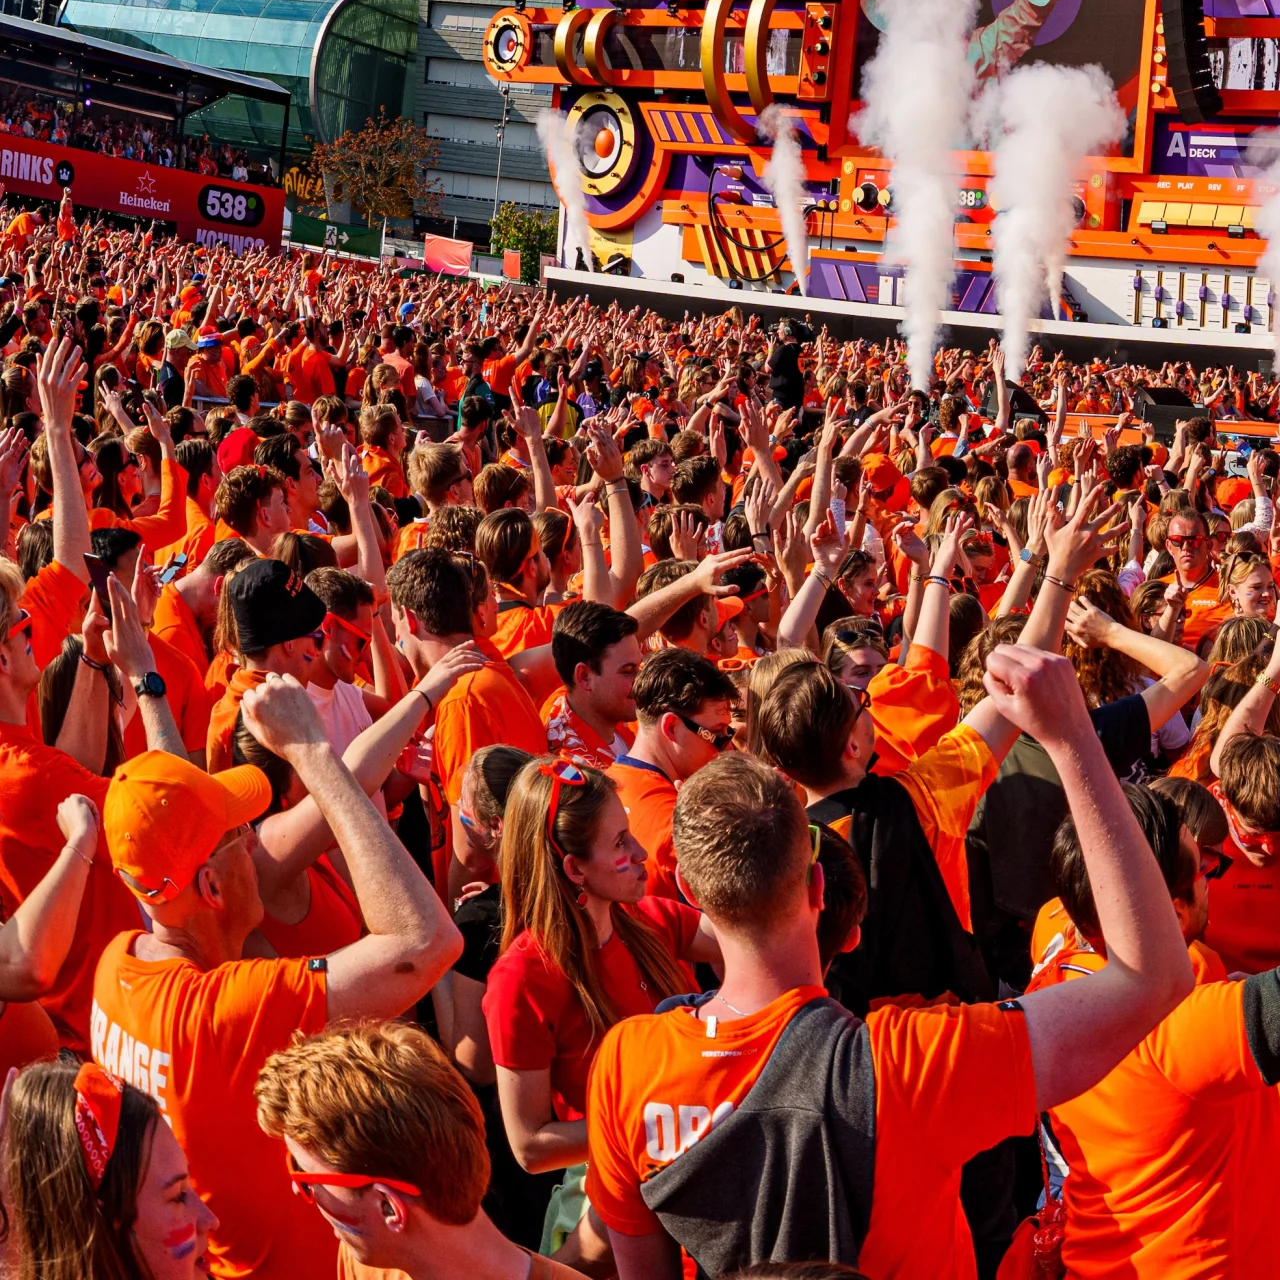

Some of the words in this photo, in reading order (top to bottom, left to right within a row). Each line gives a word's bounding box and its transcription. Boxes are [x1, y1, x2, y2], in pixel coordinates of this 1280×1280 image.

[1166, 132, 1187, 158] A
[1189, 148, 1217, 159] DECK
[0, 148, 54, 185] RINKS
[1156, 181, 1171, 189] REC
[1177, 182, 1195, 190] PLAY
[1207, 183, 1222, 191] REV
[1236, 184, 1246, 192] FF
[119, 191, 171, 212] Heineken
[206, 189, 247, 221] 538
